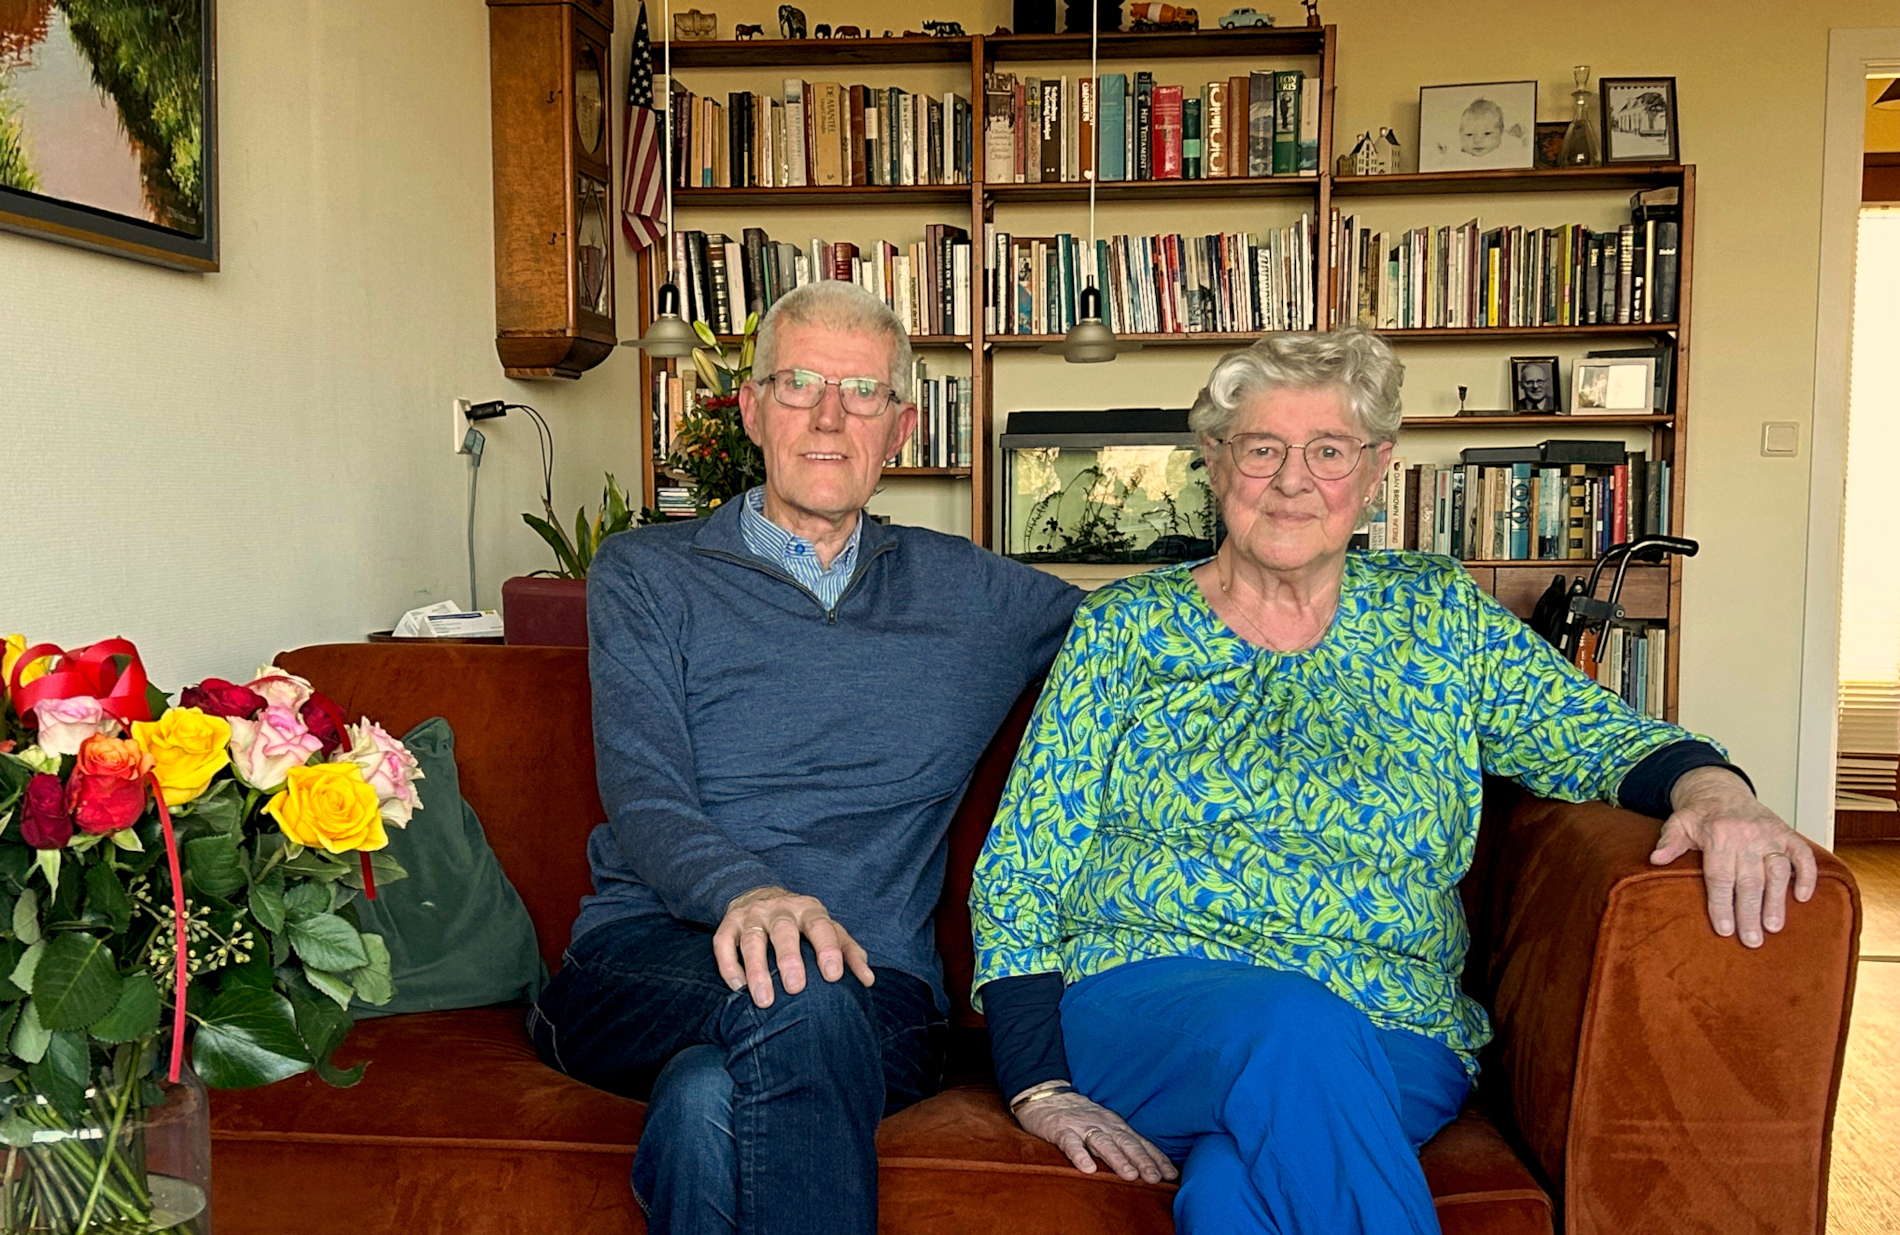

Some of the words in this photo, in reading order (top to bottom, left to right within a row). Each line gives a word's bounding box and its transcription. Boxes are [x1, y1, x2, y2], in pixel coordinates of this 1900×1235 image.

[826, 86, 834, 98] DE
[827, 99, 836, 134] MANTEL
[1140, 108, 1149, 124] HET
[1140, 125, 1149, 170] TESTAMENT
